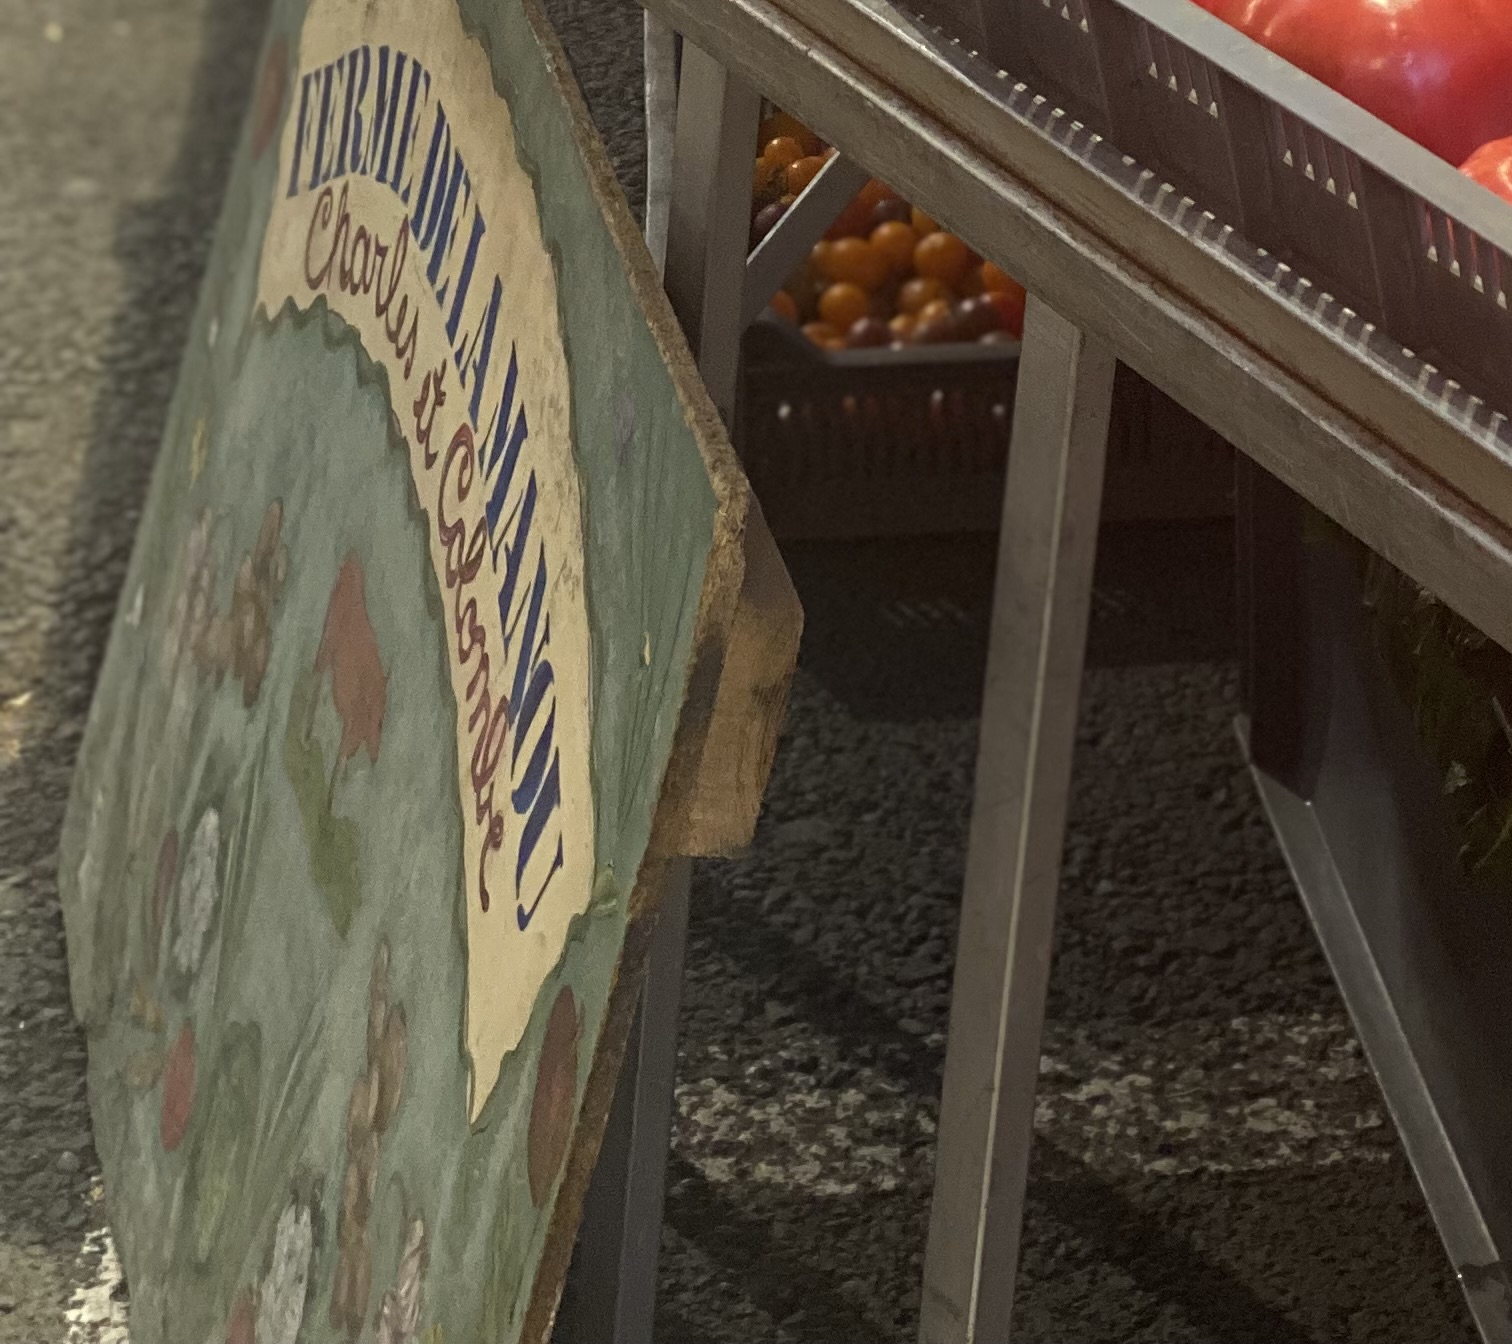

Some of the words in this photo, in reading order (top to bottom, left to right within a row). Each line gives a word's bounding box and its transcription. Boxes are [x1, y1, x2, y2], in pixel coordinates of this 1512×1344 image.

[286, 43, 432, 209] FERME
[410, 98, 472, 311] DE
[445, 202, 503, 435] LA
[477, 339, 564, 932] MANOU
[303, 179, 419, 381] Charles
[412, 358, 448, 471] et
[437, 421, 510, 914] Colombe
